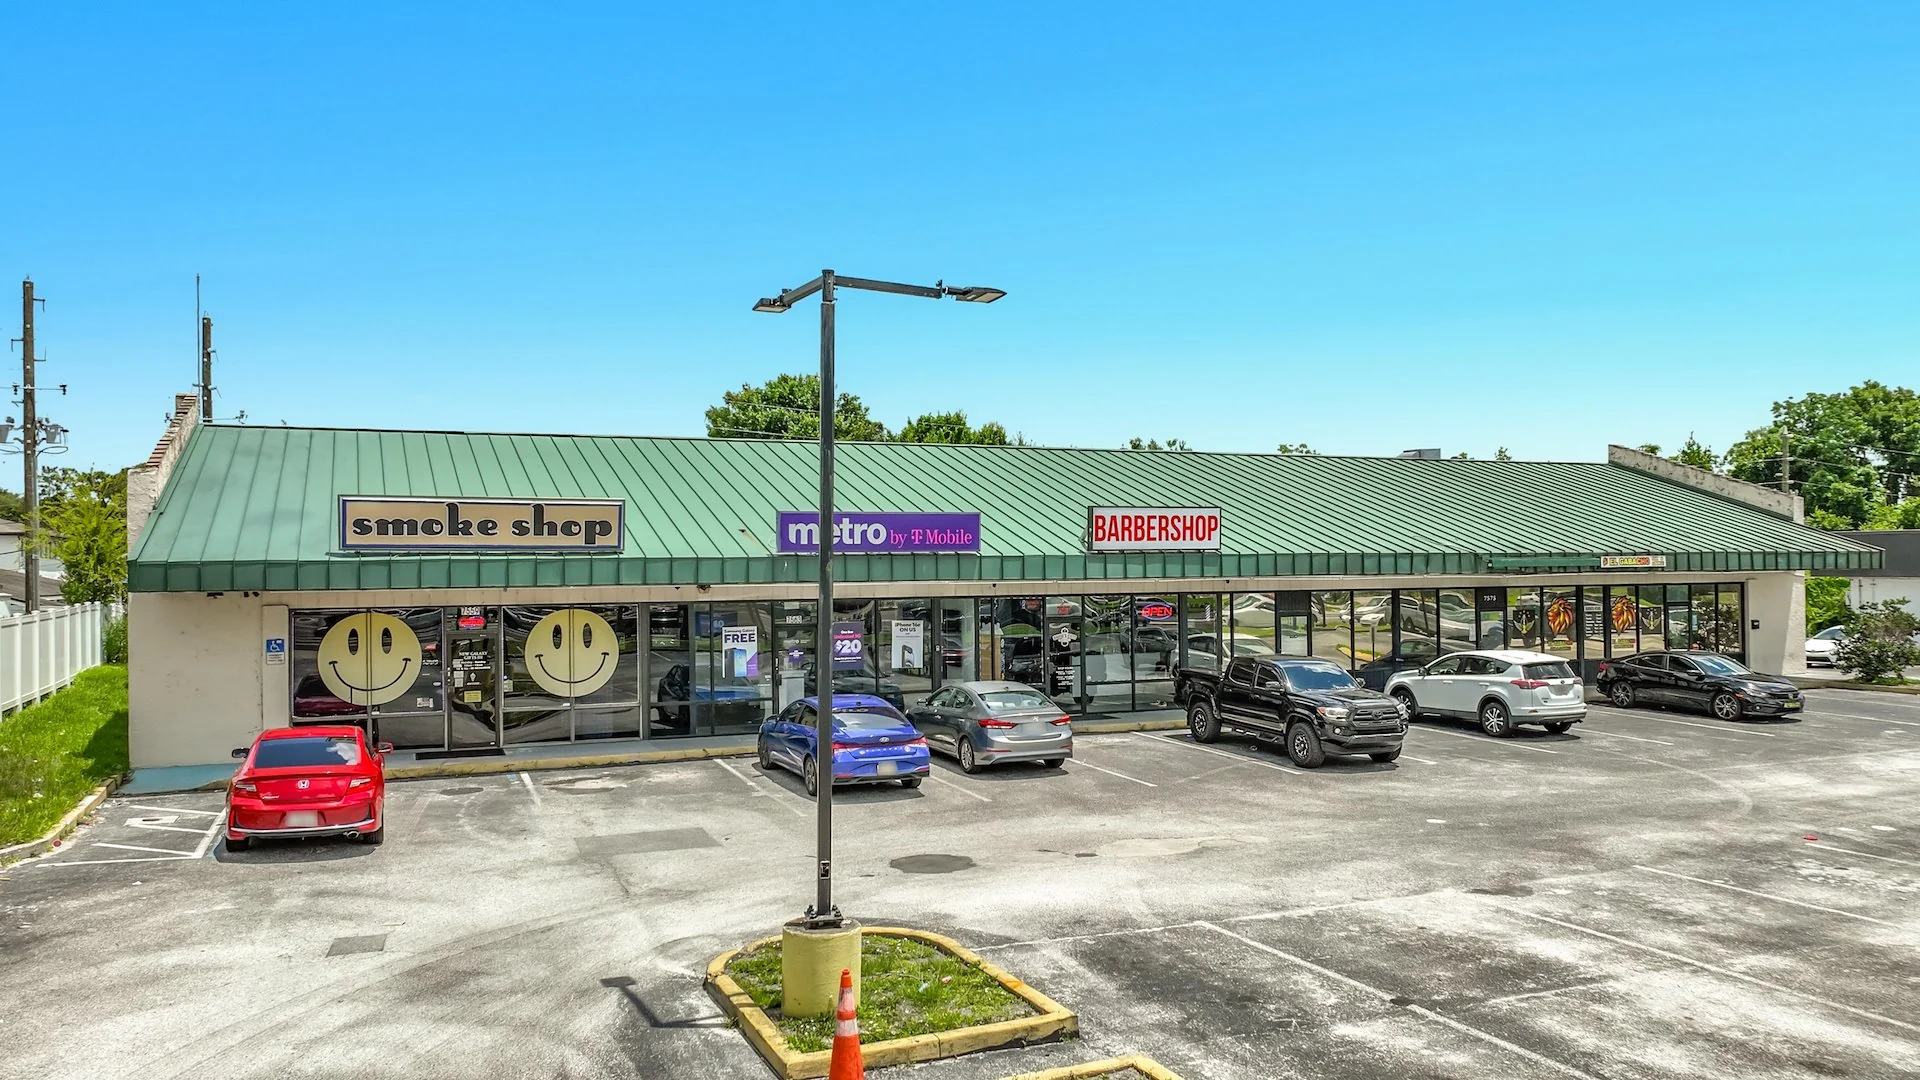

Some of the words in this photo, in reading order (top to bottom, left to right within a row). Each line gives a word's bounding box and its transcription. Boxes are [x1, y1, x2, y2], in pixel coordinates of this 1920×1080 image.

[352, 502, 499, 536] smoke
[511, 503, 613, 545] shop
[1094, 515, 1219, 542] BARBERSHOP
[890, 530, 908, 549] by
[925, 529, 973, 545] Mobile
[1619, 557, 1650, 566] GABACHO
[461, 606, 481, 616] 7559
[1141, 606, 1173, 617] OPEN
[724, 633, 756, 643] FREE
[835, 639, 862, 654] $20
